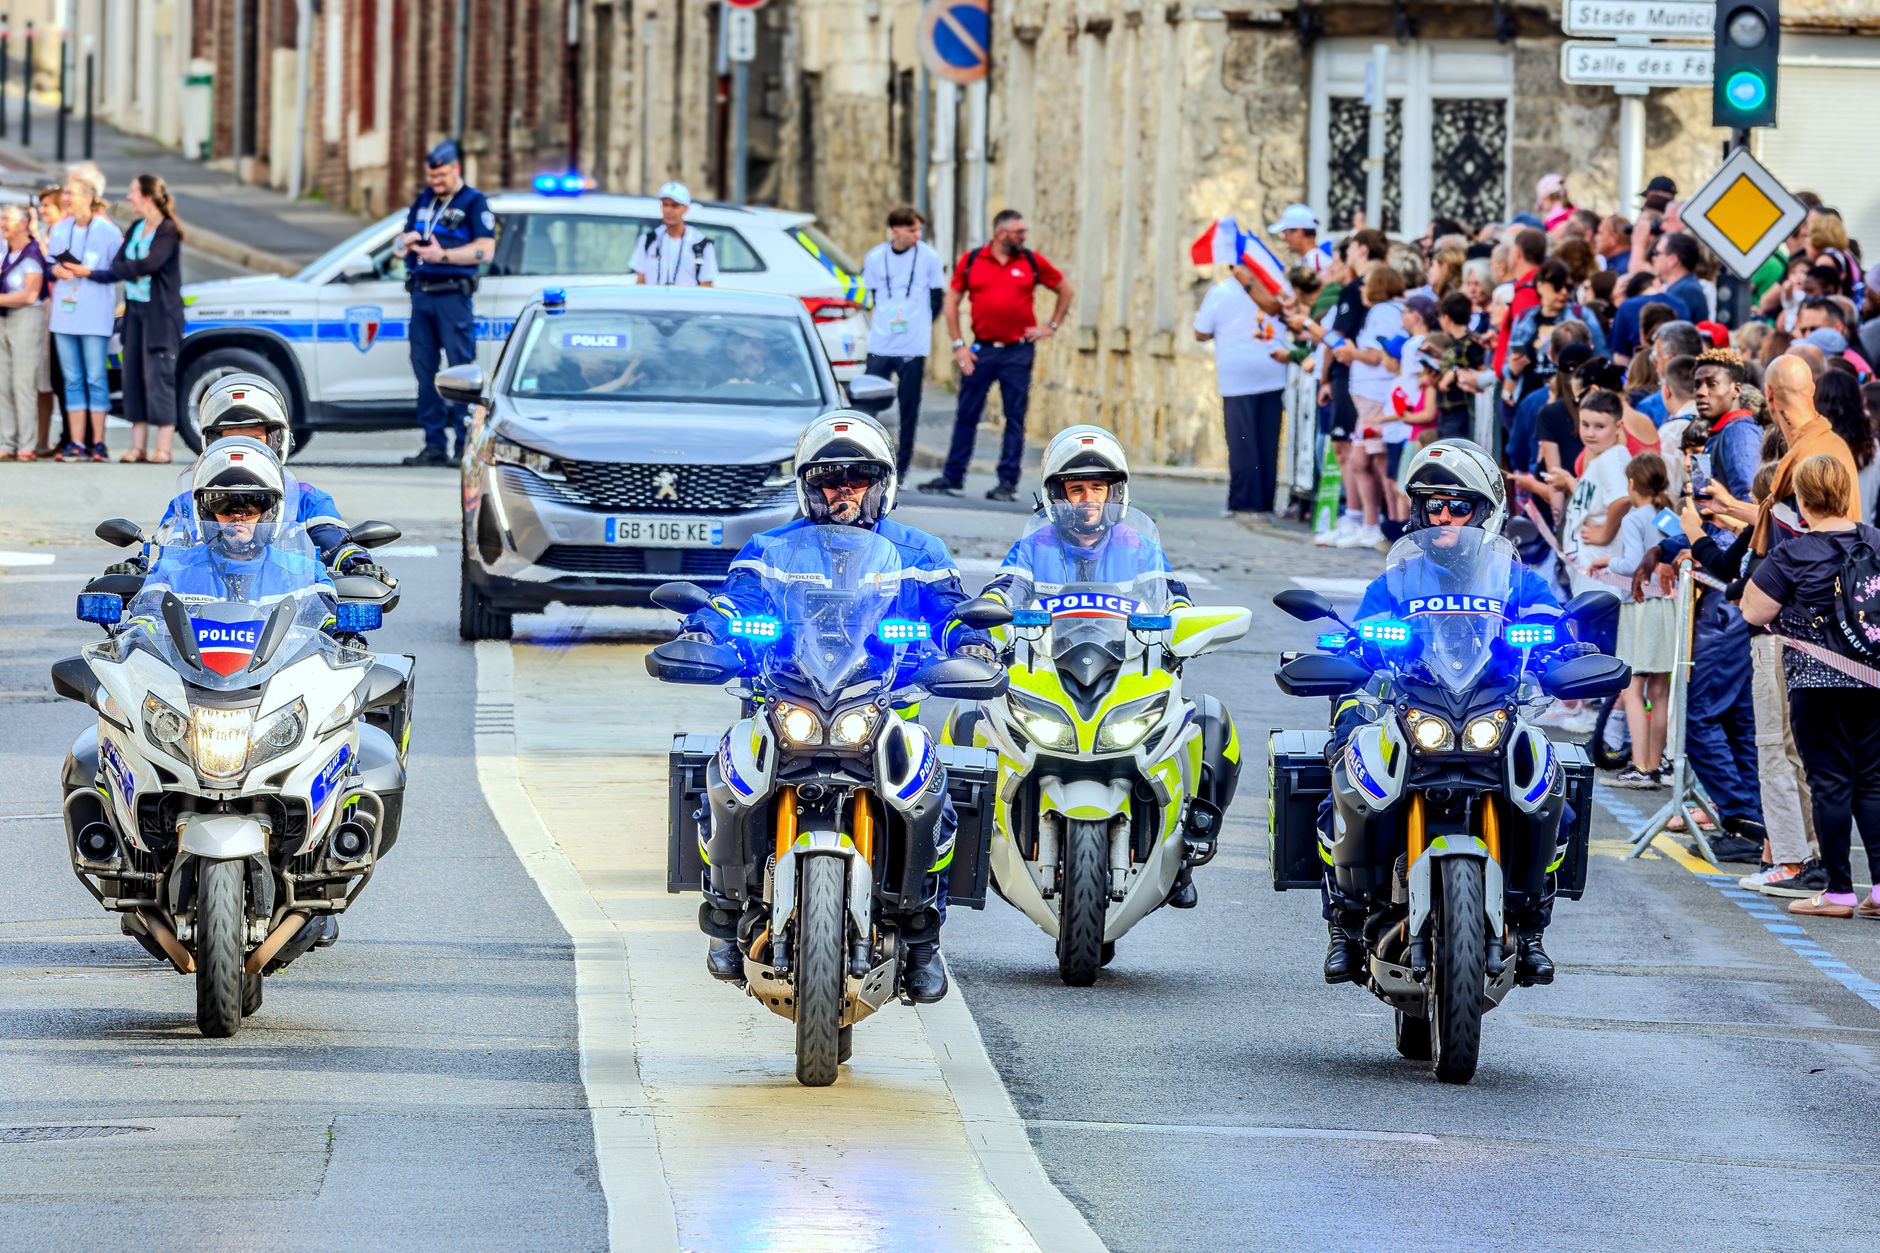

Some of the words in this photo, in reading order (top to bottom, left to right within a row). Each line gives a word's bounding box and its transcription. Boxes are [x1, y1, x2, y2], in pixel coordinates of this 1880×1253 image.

[1579, 6, 1636, 24] Stade
[1578, 55, 1626, 73] Salle
[1638, 57, 1673, 74] des
[571, 335, 618, 347] POLICE
[1046, 595, 1132, 613] POLICE
[1409, 596, 1502, 613] POLICE
[198, 629, 255, 643] POLICE
